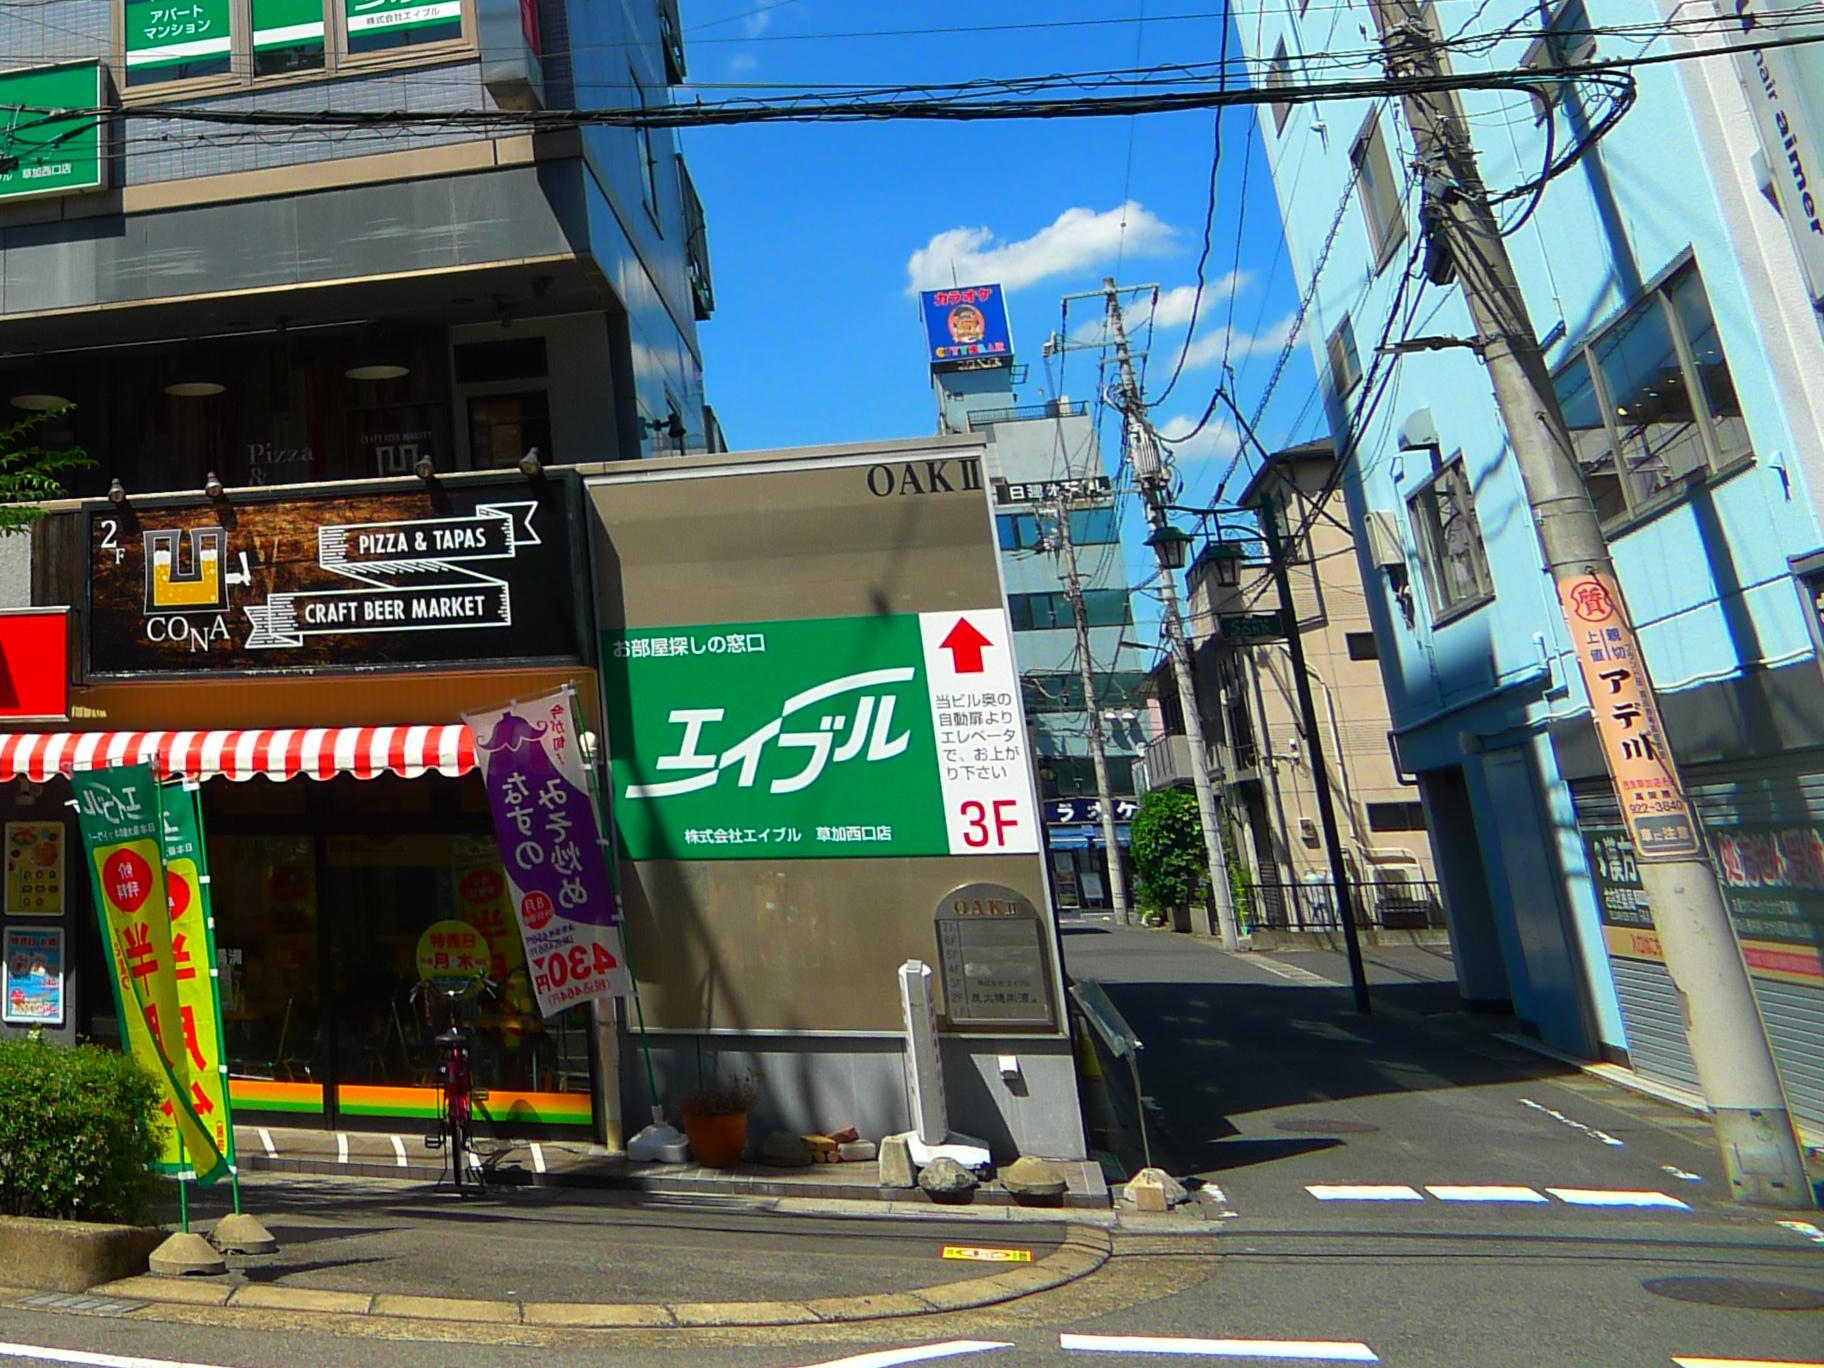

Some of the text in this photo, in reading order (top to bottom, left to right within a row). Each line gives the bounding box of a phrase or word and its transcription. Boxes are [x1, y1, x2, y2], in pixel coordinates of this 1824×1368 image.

[150, 5, 204, 23] アパート
[367, 7, 441, 26] 株式会社エイブル
[144, 19, 211, 40] マンション
[1775, 110, 1824, 237] aimer
[934, 288, 992, 307] カラオケ
[247, 442, 314, 464] Pizza
[868, 461, 955, 498] OAK
[359, 527, 487, 555] PIZZA & TAPAS
[304, 595, 485, 625] CRAFT BEER MARKET
[1578, 587, 1607, 616] 質
[146, 616, 230, 652] CONA
[613, 634, 766, 659] お部屋探しの窓口
[935, 693, 1012, 710] 当ビル奥の
[939, 710, 1013, 727] 自動扉より
[625, 667, 915, 799] エイブル
[941, 729, 1016, 745] エレベータ
[943, 746, 1020, 762] で、お上が
[946, 765, 1007, 781] り下さい
[815, 825, 892, 842] 草加西口店
[960, 800, 1018, 847] 3F
[684, 828, 801, 844] 株式会社エイブル
[954, 899, 1003, 916] OAK
